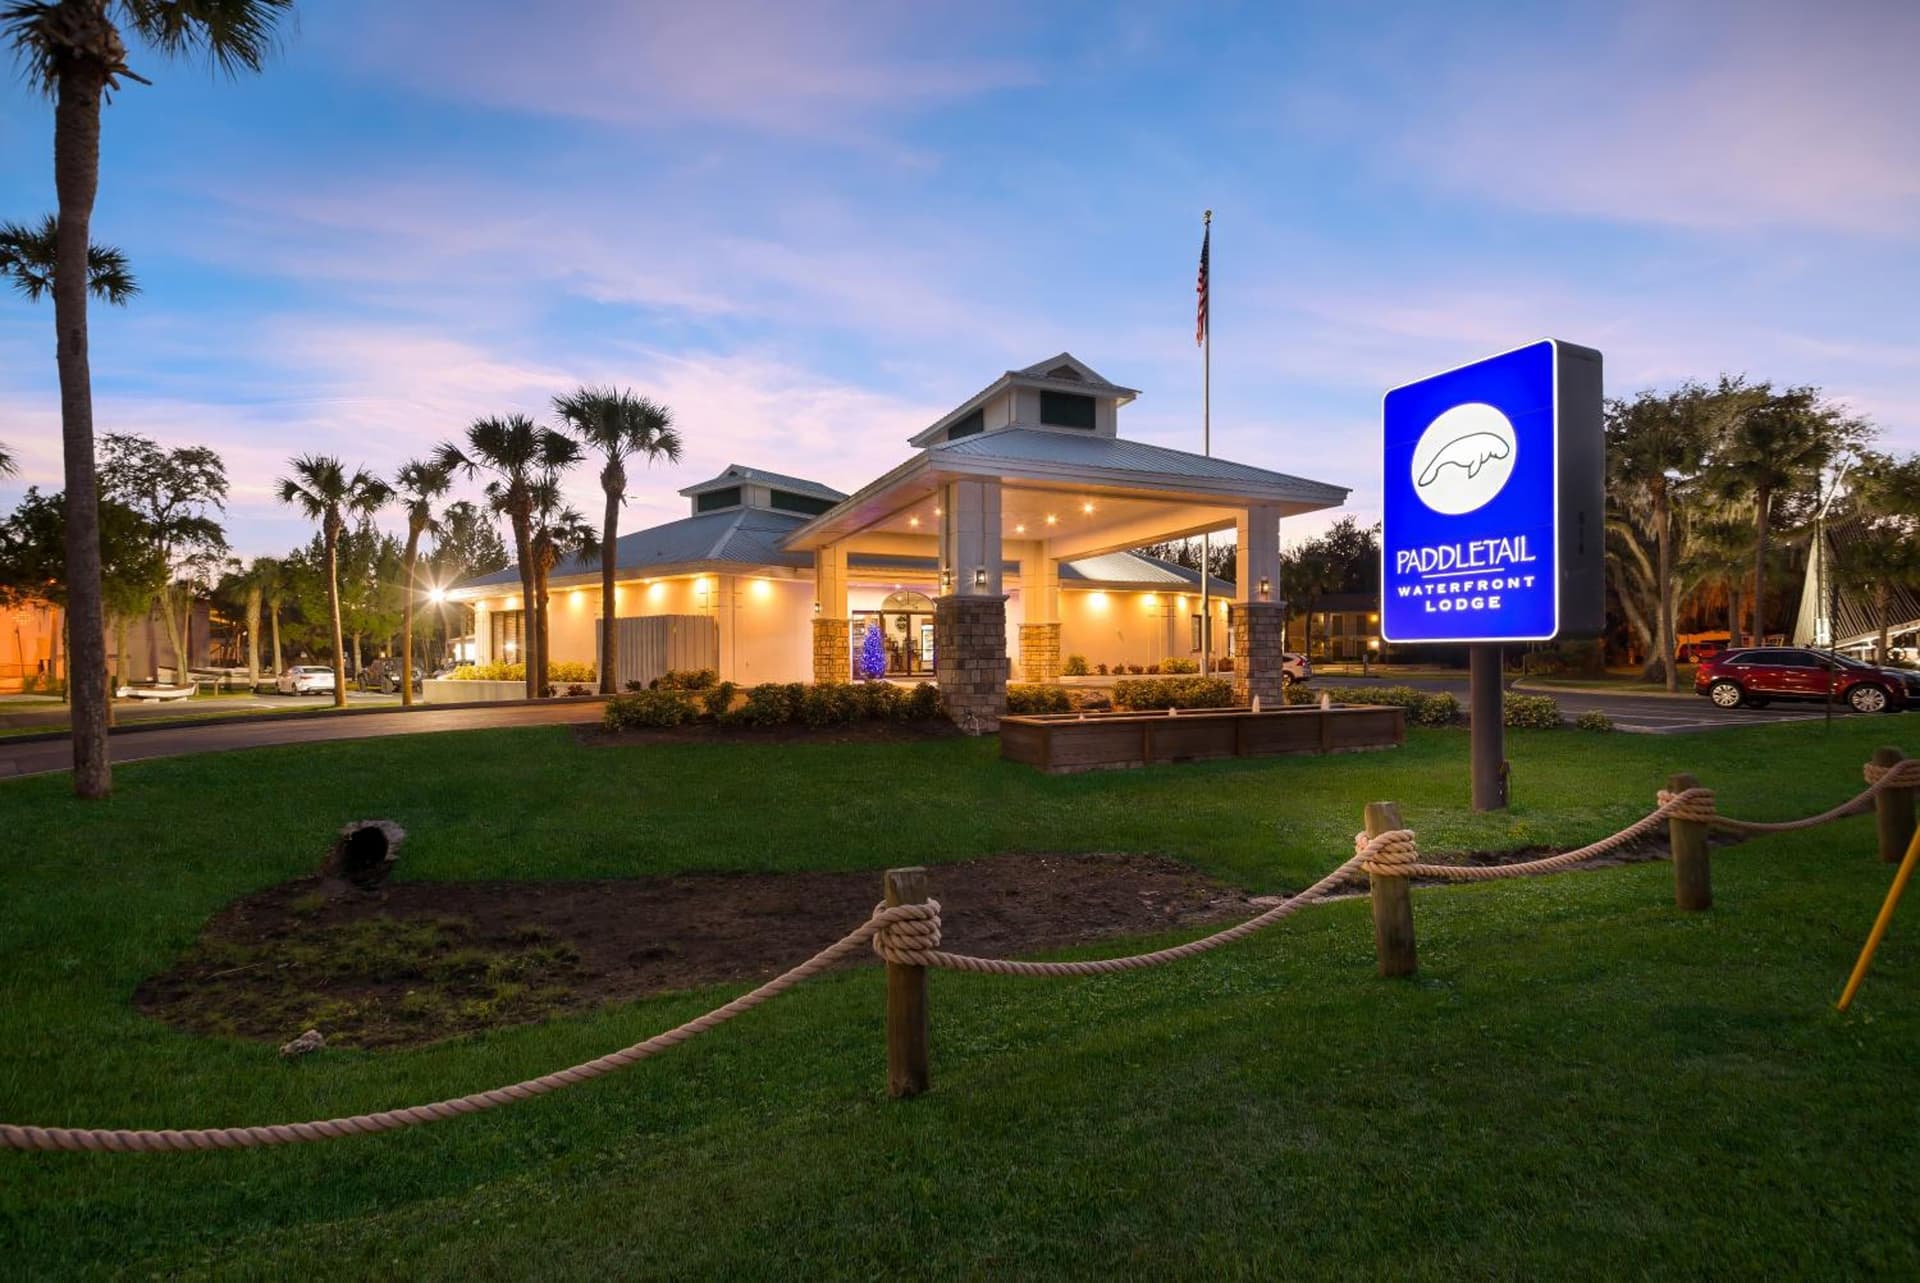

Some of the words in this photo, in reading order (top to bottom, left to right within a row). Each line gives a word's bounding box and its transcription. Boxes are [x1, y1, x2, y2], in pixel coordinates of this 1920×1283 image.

[1397, 535, 1536, 574] PADDLETAIL
[1398, 576, 1535, 597] WATERFRONT
[1425, 595, 1501, 612] LODGE
